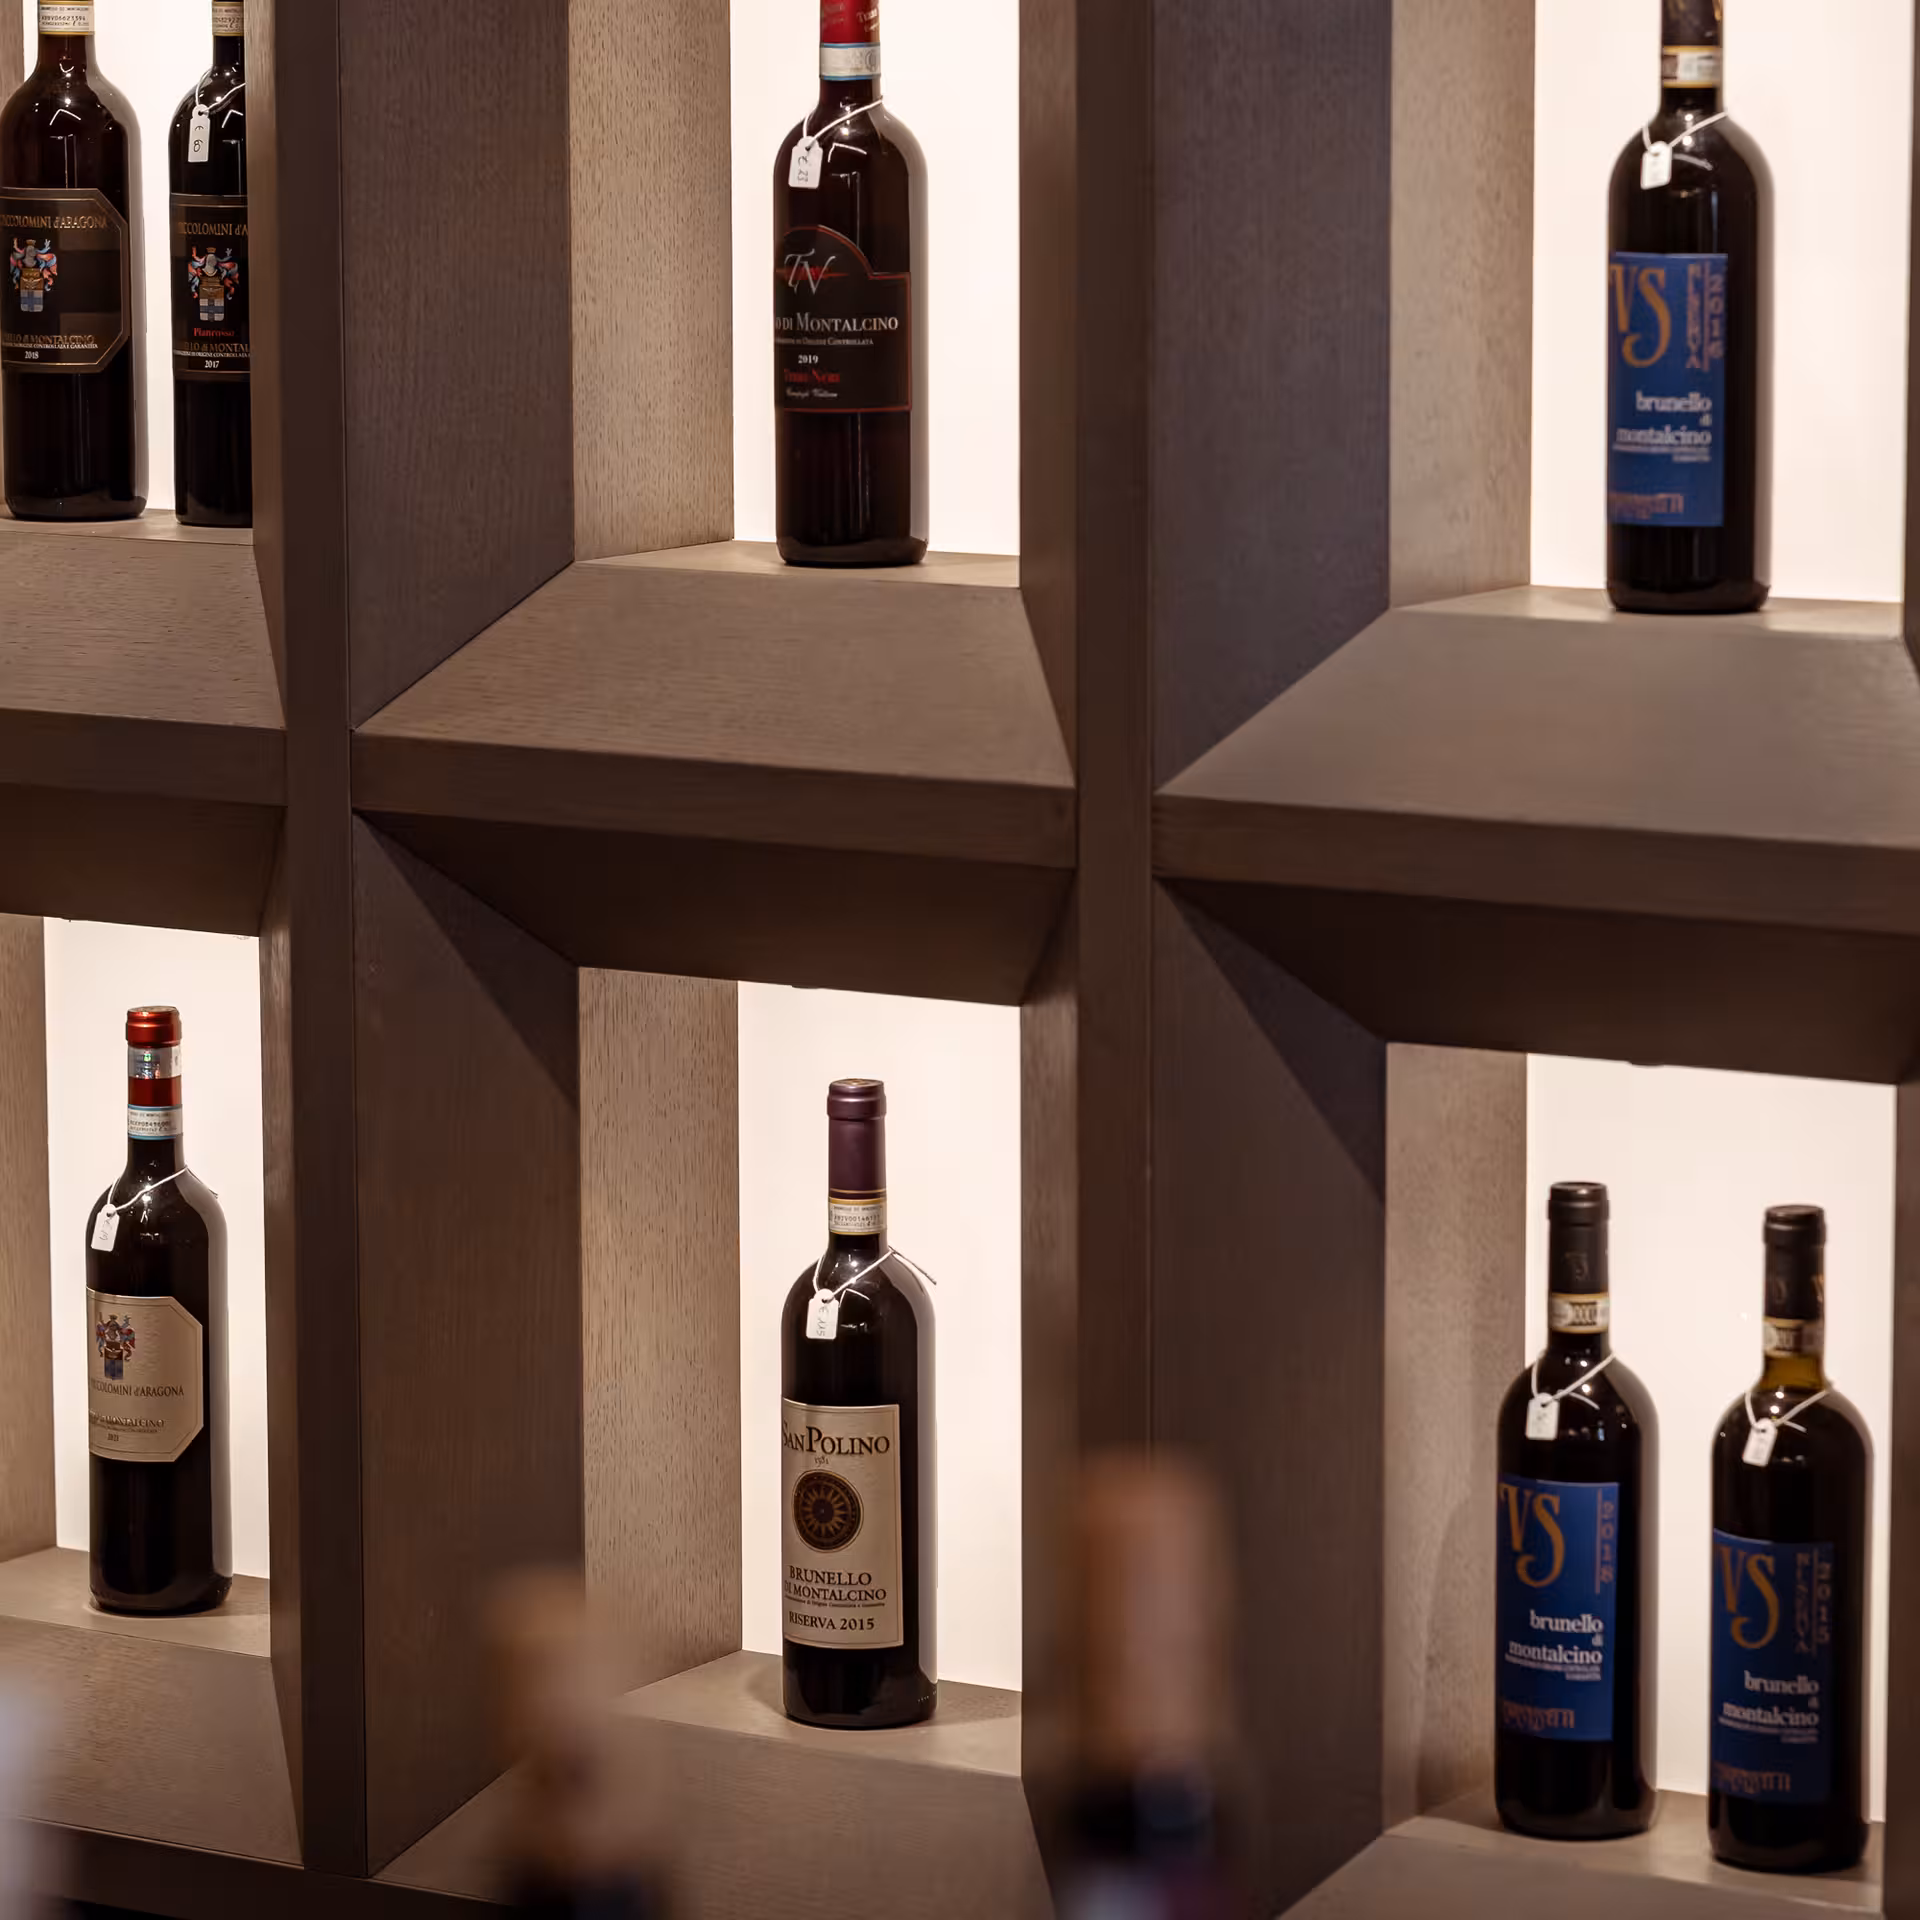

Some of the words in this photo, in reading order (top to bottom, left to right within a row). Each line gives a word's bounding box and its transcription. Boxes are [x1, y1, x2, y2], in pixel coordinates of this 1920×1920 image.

[796, 312, 899, 332] MONTALCINO
[204, 359, 220, 369] 2017
[798, 354, 819, 364] 2019
[1636, 390, 1712, 412] brunello
[134, 1382, 184, 1398] d'ARAGONA
[1499, 1482, 1565, 1589] VS
[789, 1565, 872, 1586] BRUNELLO
[784, 1579, 793, 1594] DI
[794, 1583, 887, 1601] MONTALCINO
[1720, 1546, 1780, 1650] VS
[789, 1610, 836, 1630] RISERVA
[840, 1617, 875, 1631] 2015
[1529, 1609, 1604, 1634] brunello
[1508, 1640, 1603, 1664] montalcino
[1744, 1670, 1820, 1695] brunello
[1722, 1701, 1820, 1727] montalcino
